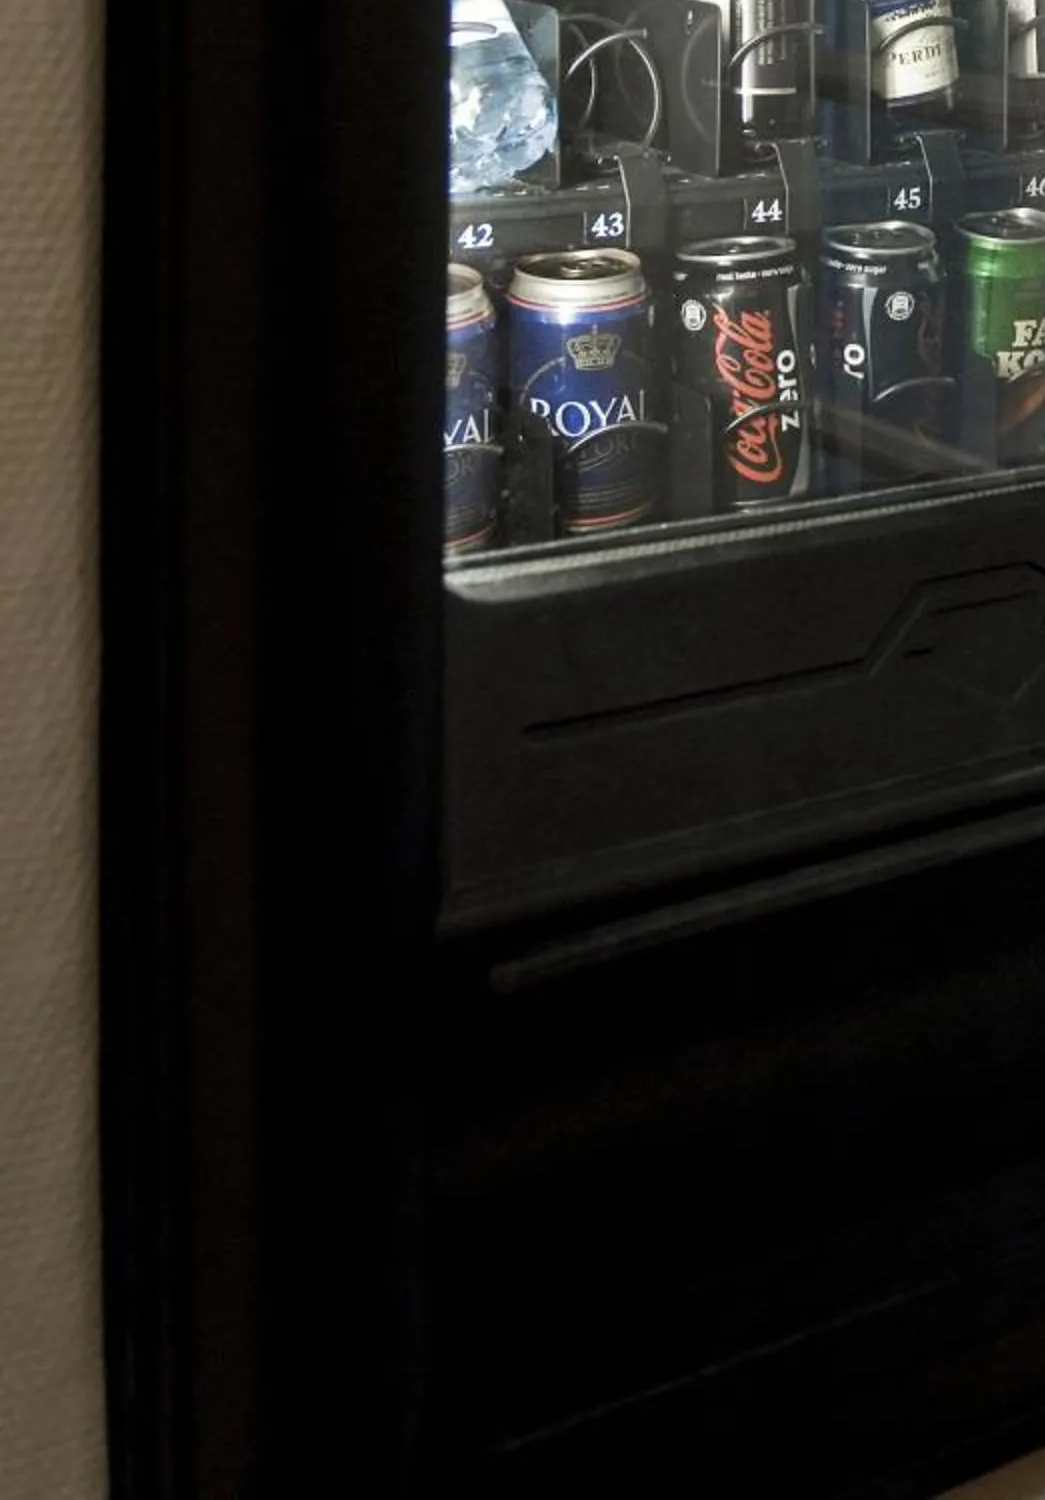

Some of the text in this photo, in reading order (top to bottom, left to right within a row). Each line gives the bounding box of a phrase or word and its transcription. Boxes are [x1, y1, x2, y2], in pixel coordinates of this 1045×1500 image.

[893, 186, 921, 210] 45
[751, 200, 783, 223] 44
[458, 223, 494, 249] 42
[591, 212, 624, 238] 43
